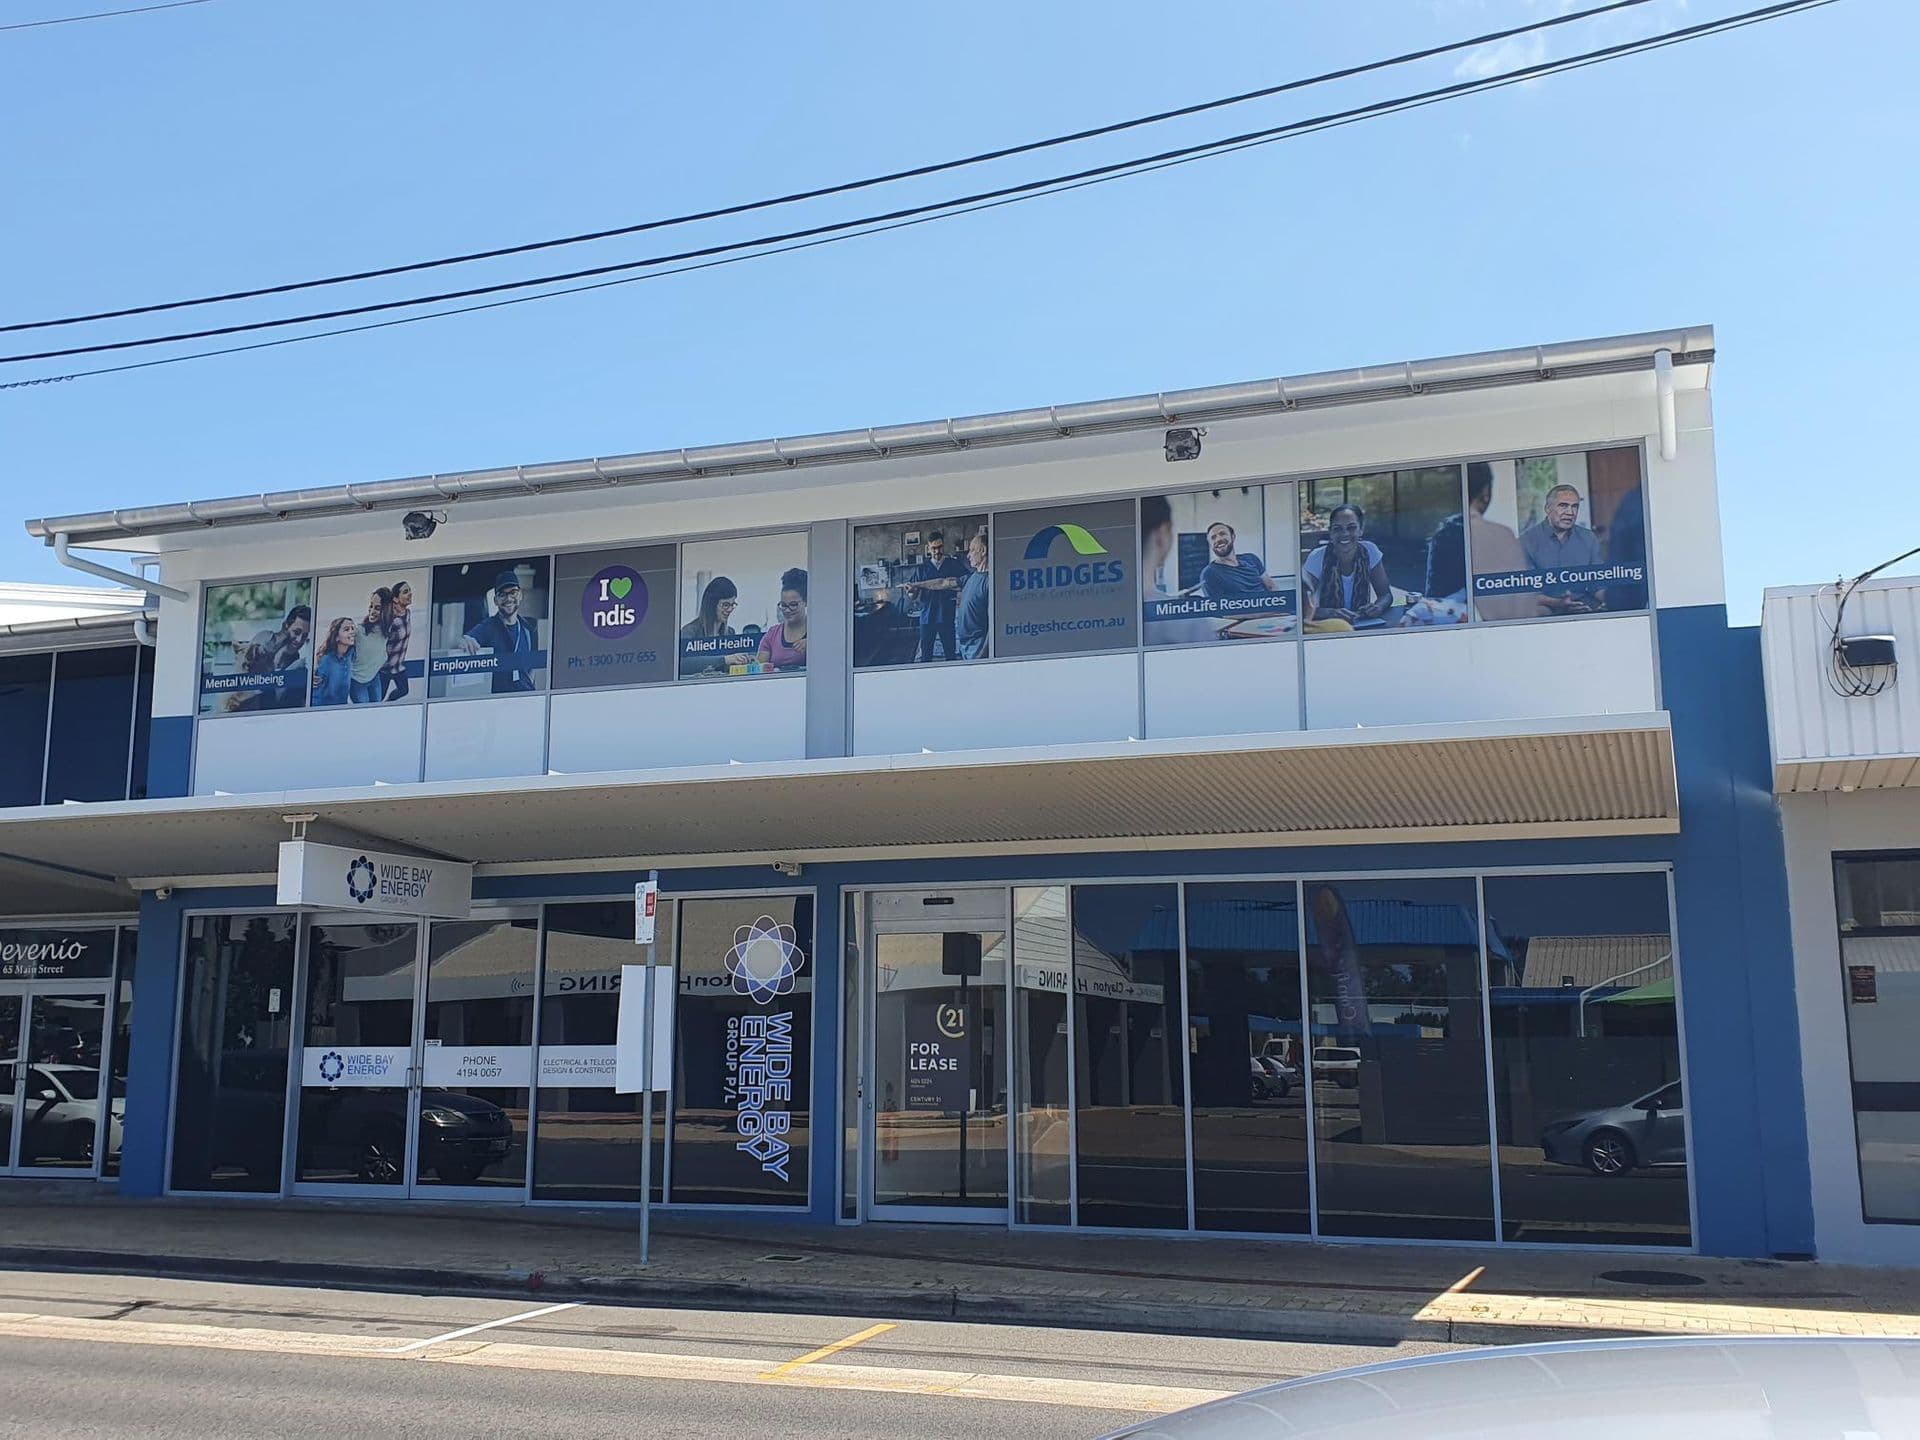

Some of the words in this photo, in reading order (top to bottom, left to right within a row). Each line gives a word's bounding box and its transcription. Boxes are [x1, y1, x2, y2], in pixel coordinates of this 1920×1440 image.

[1010, 560, 1124, 591] BRIDGES
[1476, 574, 1543, 589] Coaching
[1545, 572, 1557, 584] &
[1559, 565, 1643, 583] Counselling
[600, 579, 609, 602] I
[1156, 599, 1217, 615] Mind-Life
[1220, 595, 1287, 610] Resources
[593, 603, 636, 627] ndis
[1006, 617, 1125, 636] bridgeshcc.com.au
[686, 639, 717, 652] Allied
[719, 636, 754, 649] Health
[433, 657, 498, 673] Employment
[589, 655, 613, 666] 1300
[637, 650, 657, 663] 655
[205, 676, 238, 689] Mental
[240, 673, 284, 687] Wellbeing
[380, 863, 409, 881] WIDE
[412, 868, 433, 883] BAY
[381, 880, 426, 898] ENERGY
[0, 938, 88, 961] evenio
[2, 965, 13, 974] 65
[14, 965, 37, 974] Main
[38, 964, 64, 974] Street
[726, 1017, 739, 1072] GROUP
[910, 1043, 940, 1055] FOR
[347, 1054, 373, 1065] WIDE
[375, 1054, 394, 1065] BAY
[463, 1056, 497, 1065] PHONE
[543, 1058, 582, 1066] ELECTRICAL
[590, 1058, 617, 1066] TELECO
[764, 1011, 793, 1101] WIDE
[910, 1058, 958, 1071] LEASE
[347, 1065, 389, 1075] ENERGY
[456, 1068, 478, 1077] 4194
[480, 1067, 502, 1078] 0057
[543, 1066, 568, 1074] DESIGN
[723, 1077, 737, 1104] P/L
[736, 1015, 767, 1161] ENERGY
[762, 1111, 791, 1182] BAY
